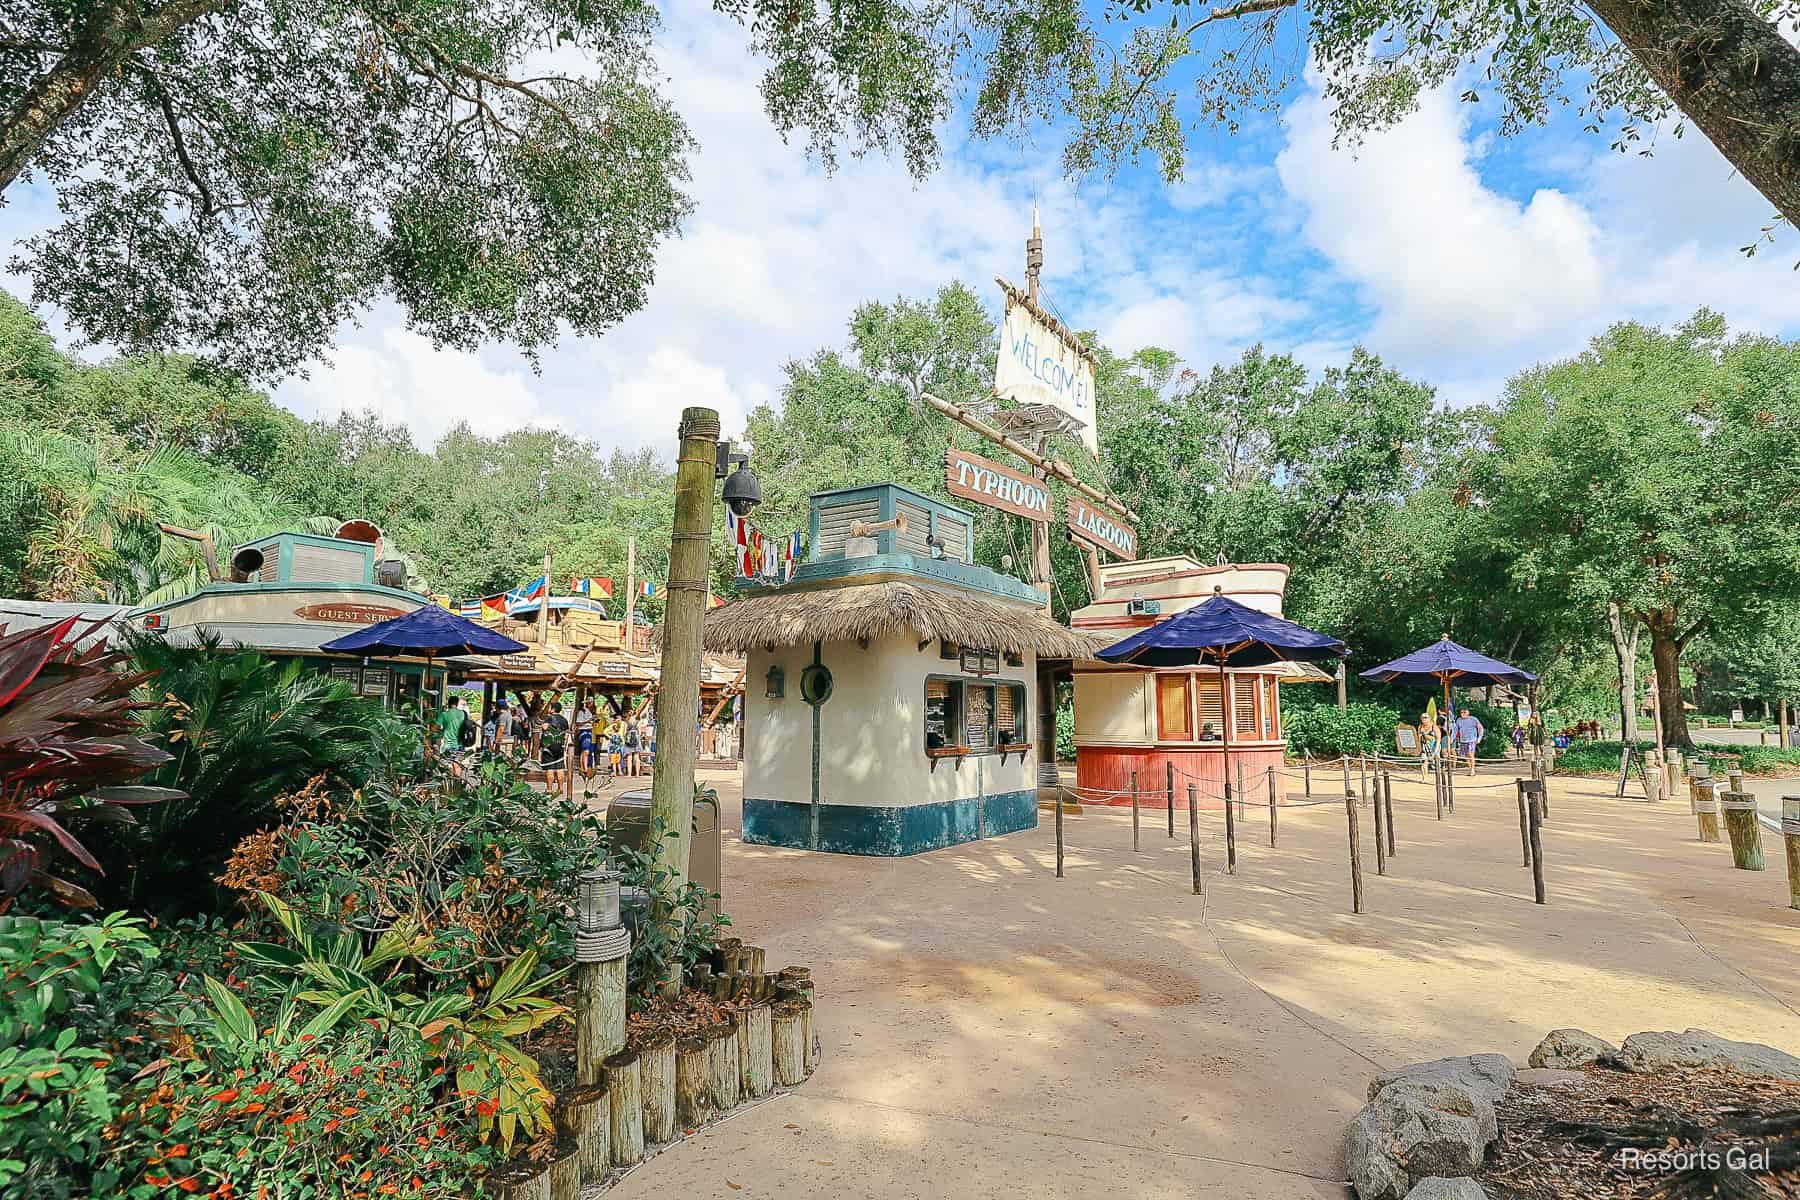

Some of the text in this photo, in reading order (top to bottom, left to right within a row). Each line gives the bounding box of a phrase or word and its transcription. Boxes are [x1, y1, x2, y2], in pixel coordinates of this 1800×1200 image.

[956, 459, 1049, 513] TYPHOON
[1077, 507, 1133, 550] LAGOON
[318, 609, 359, 620] GUEST
